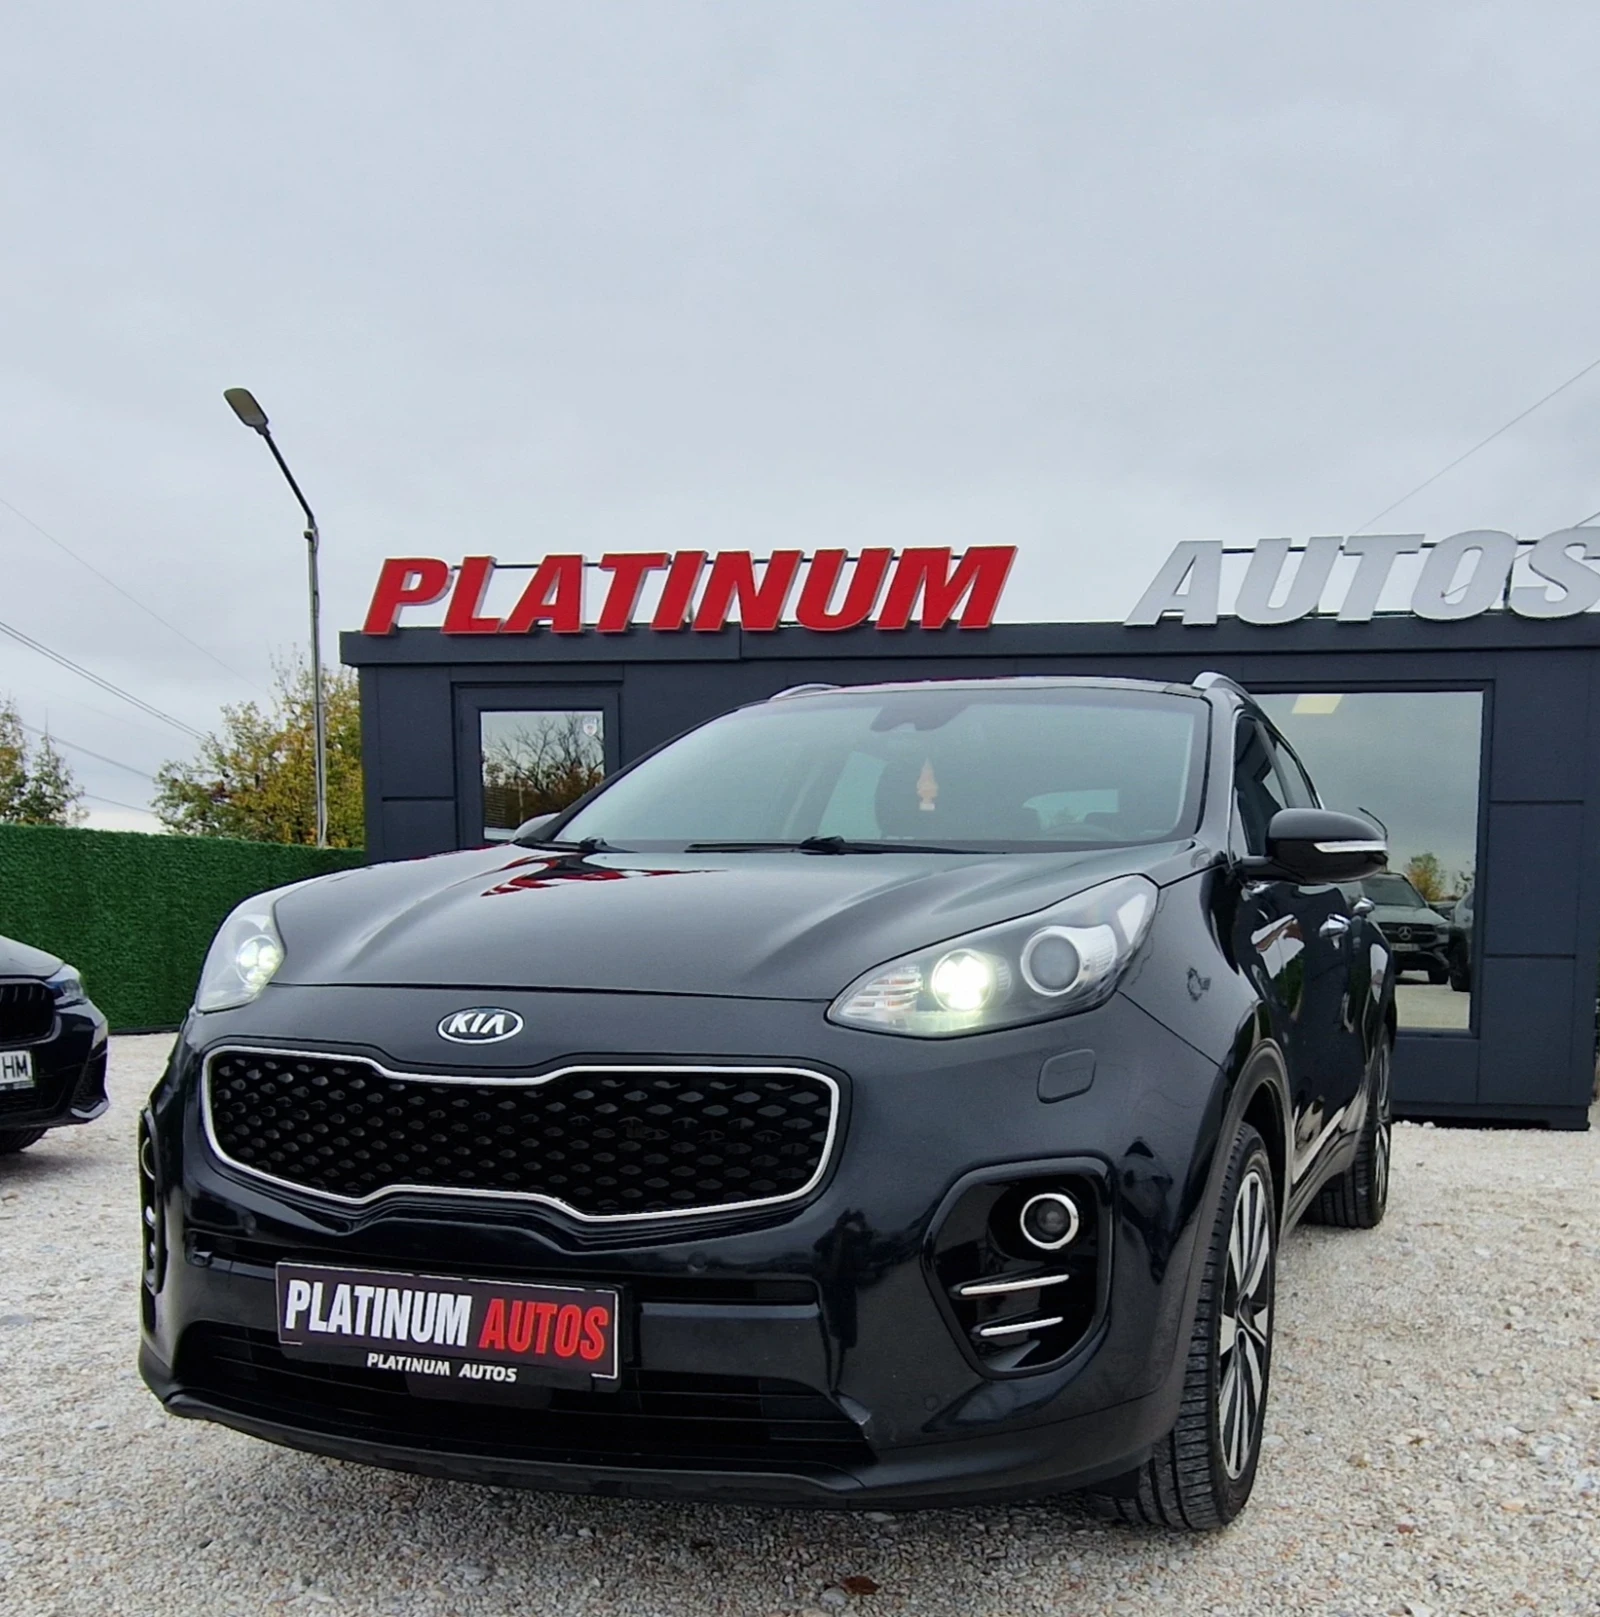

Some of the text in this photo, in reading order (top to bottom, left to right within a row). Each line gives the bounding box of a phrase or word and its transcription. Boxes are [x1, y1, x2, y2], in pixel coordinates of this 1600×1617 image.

[362, 528, 1600, 635] PLATINUM AUTOS
[448, 1012, 506, 1035] KIA
[284, 1279, 609, 1361] PLATINUM AUTOS
[366, 1352, 518, 1383] PLATINUM AUTOS
